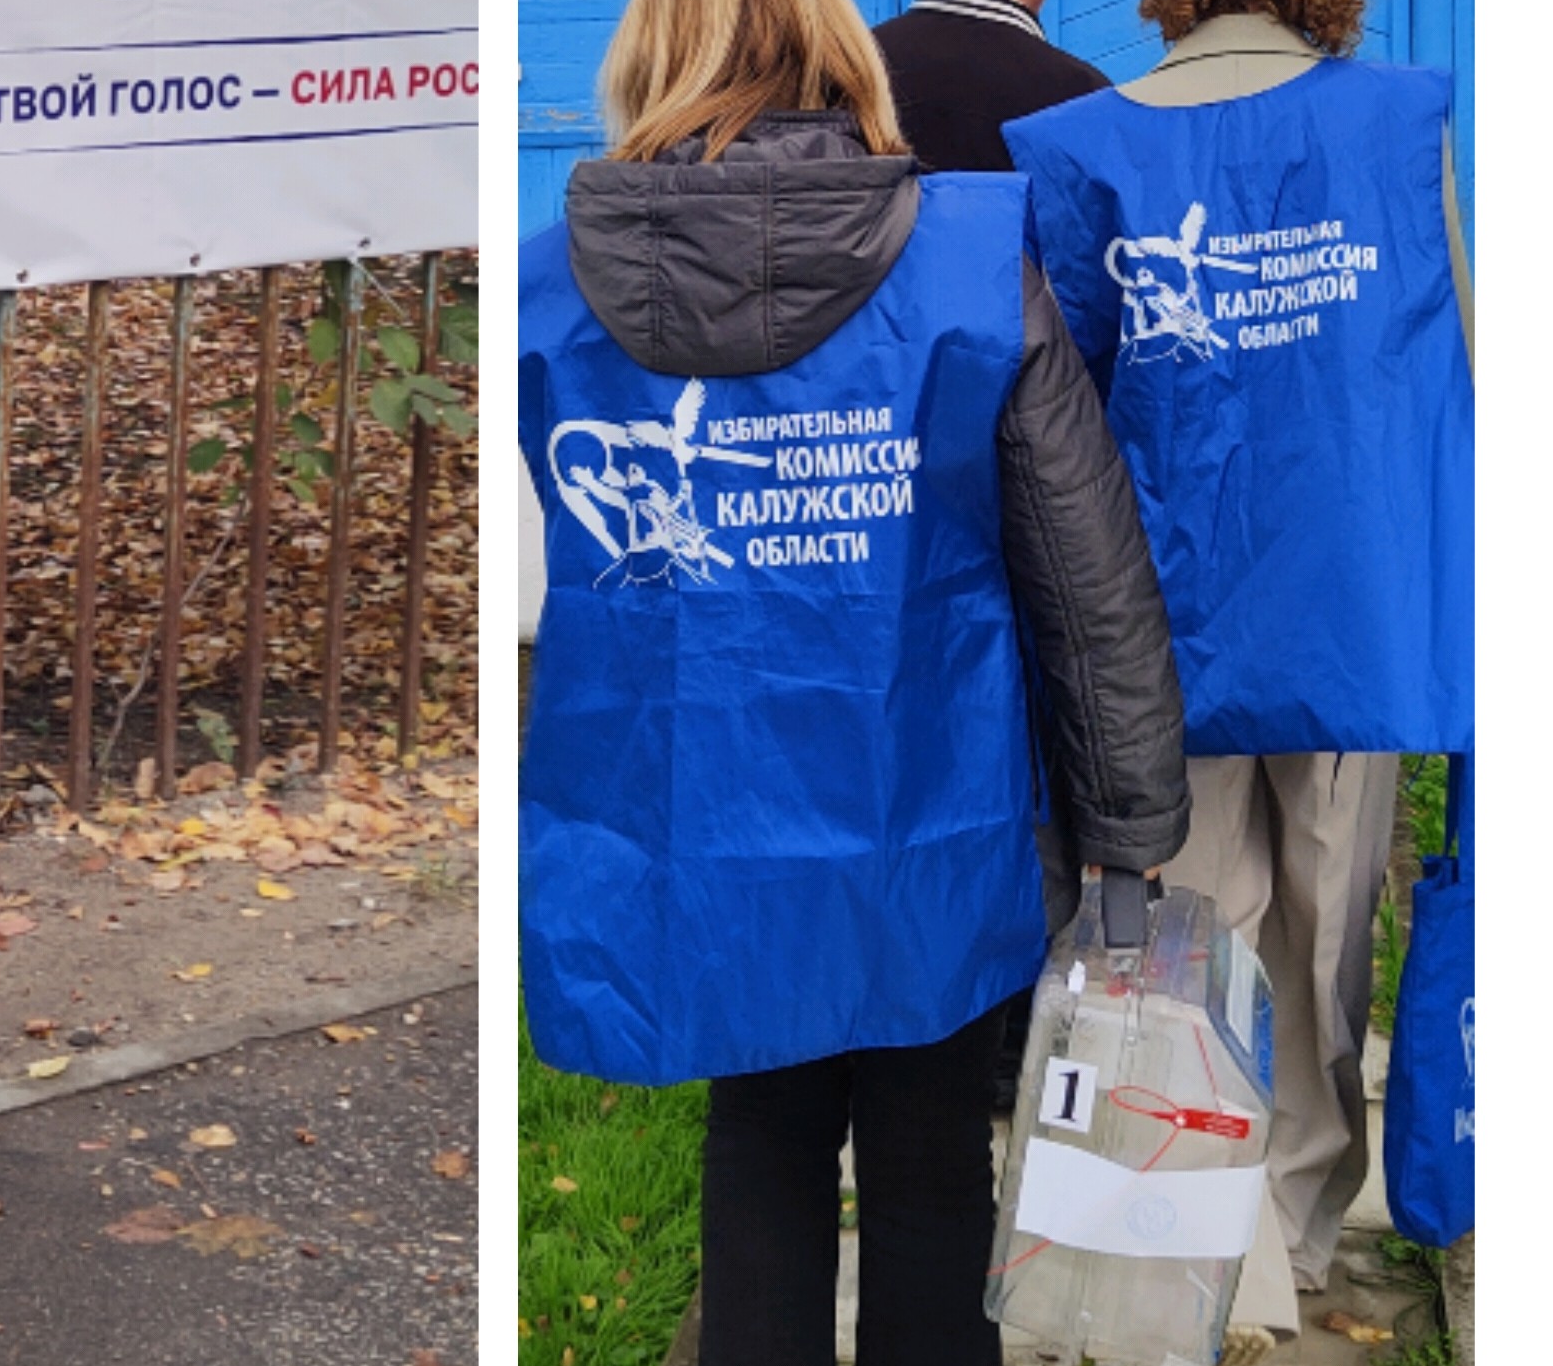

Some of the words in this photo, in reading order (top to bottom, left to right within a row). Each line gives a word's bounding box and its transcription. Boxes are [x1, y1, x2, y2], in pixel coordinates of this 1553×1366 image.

[109, 76, 241, 115] ГОЛОС
[291, 67, 395, 104] СИЛА
[407, 62, 478, 97] РОС
[707, 407, 892, 444] ИЗБИРАТЕЛЬНАЯ
[717, 473, 915, 527] КАЛУЖСКОЙ
[747, 532, 870, 567] ОБЛАСТИ
[1055, 1069, 1080, 1123] 1
